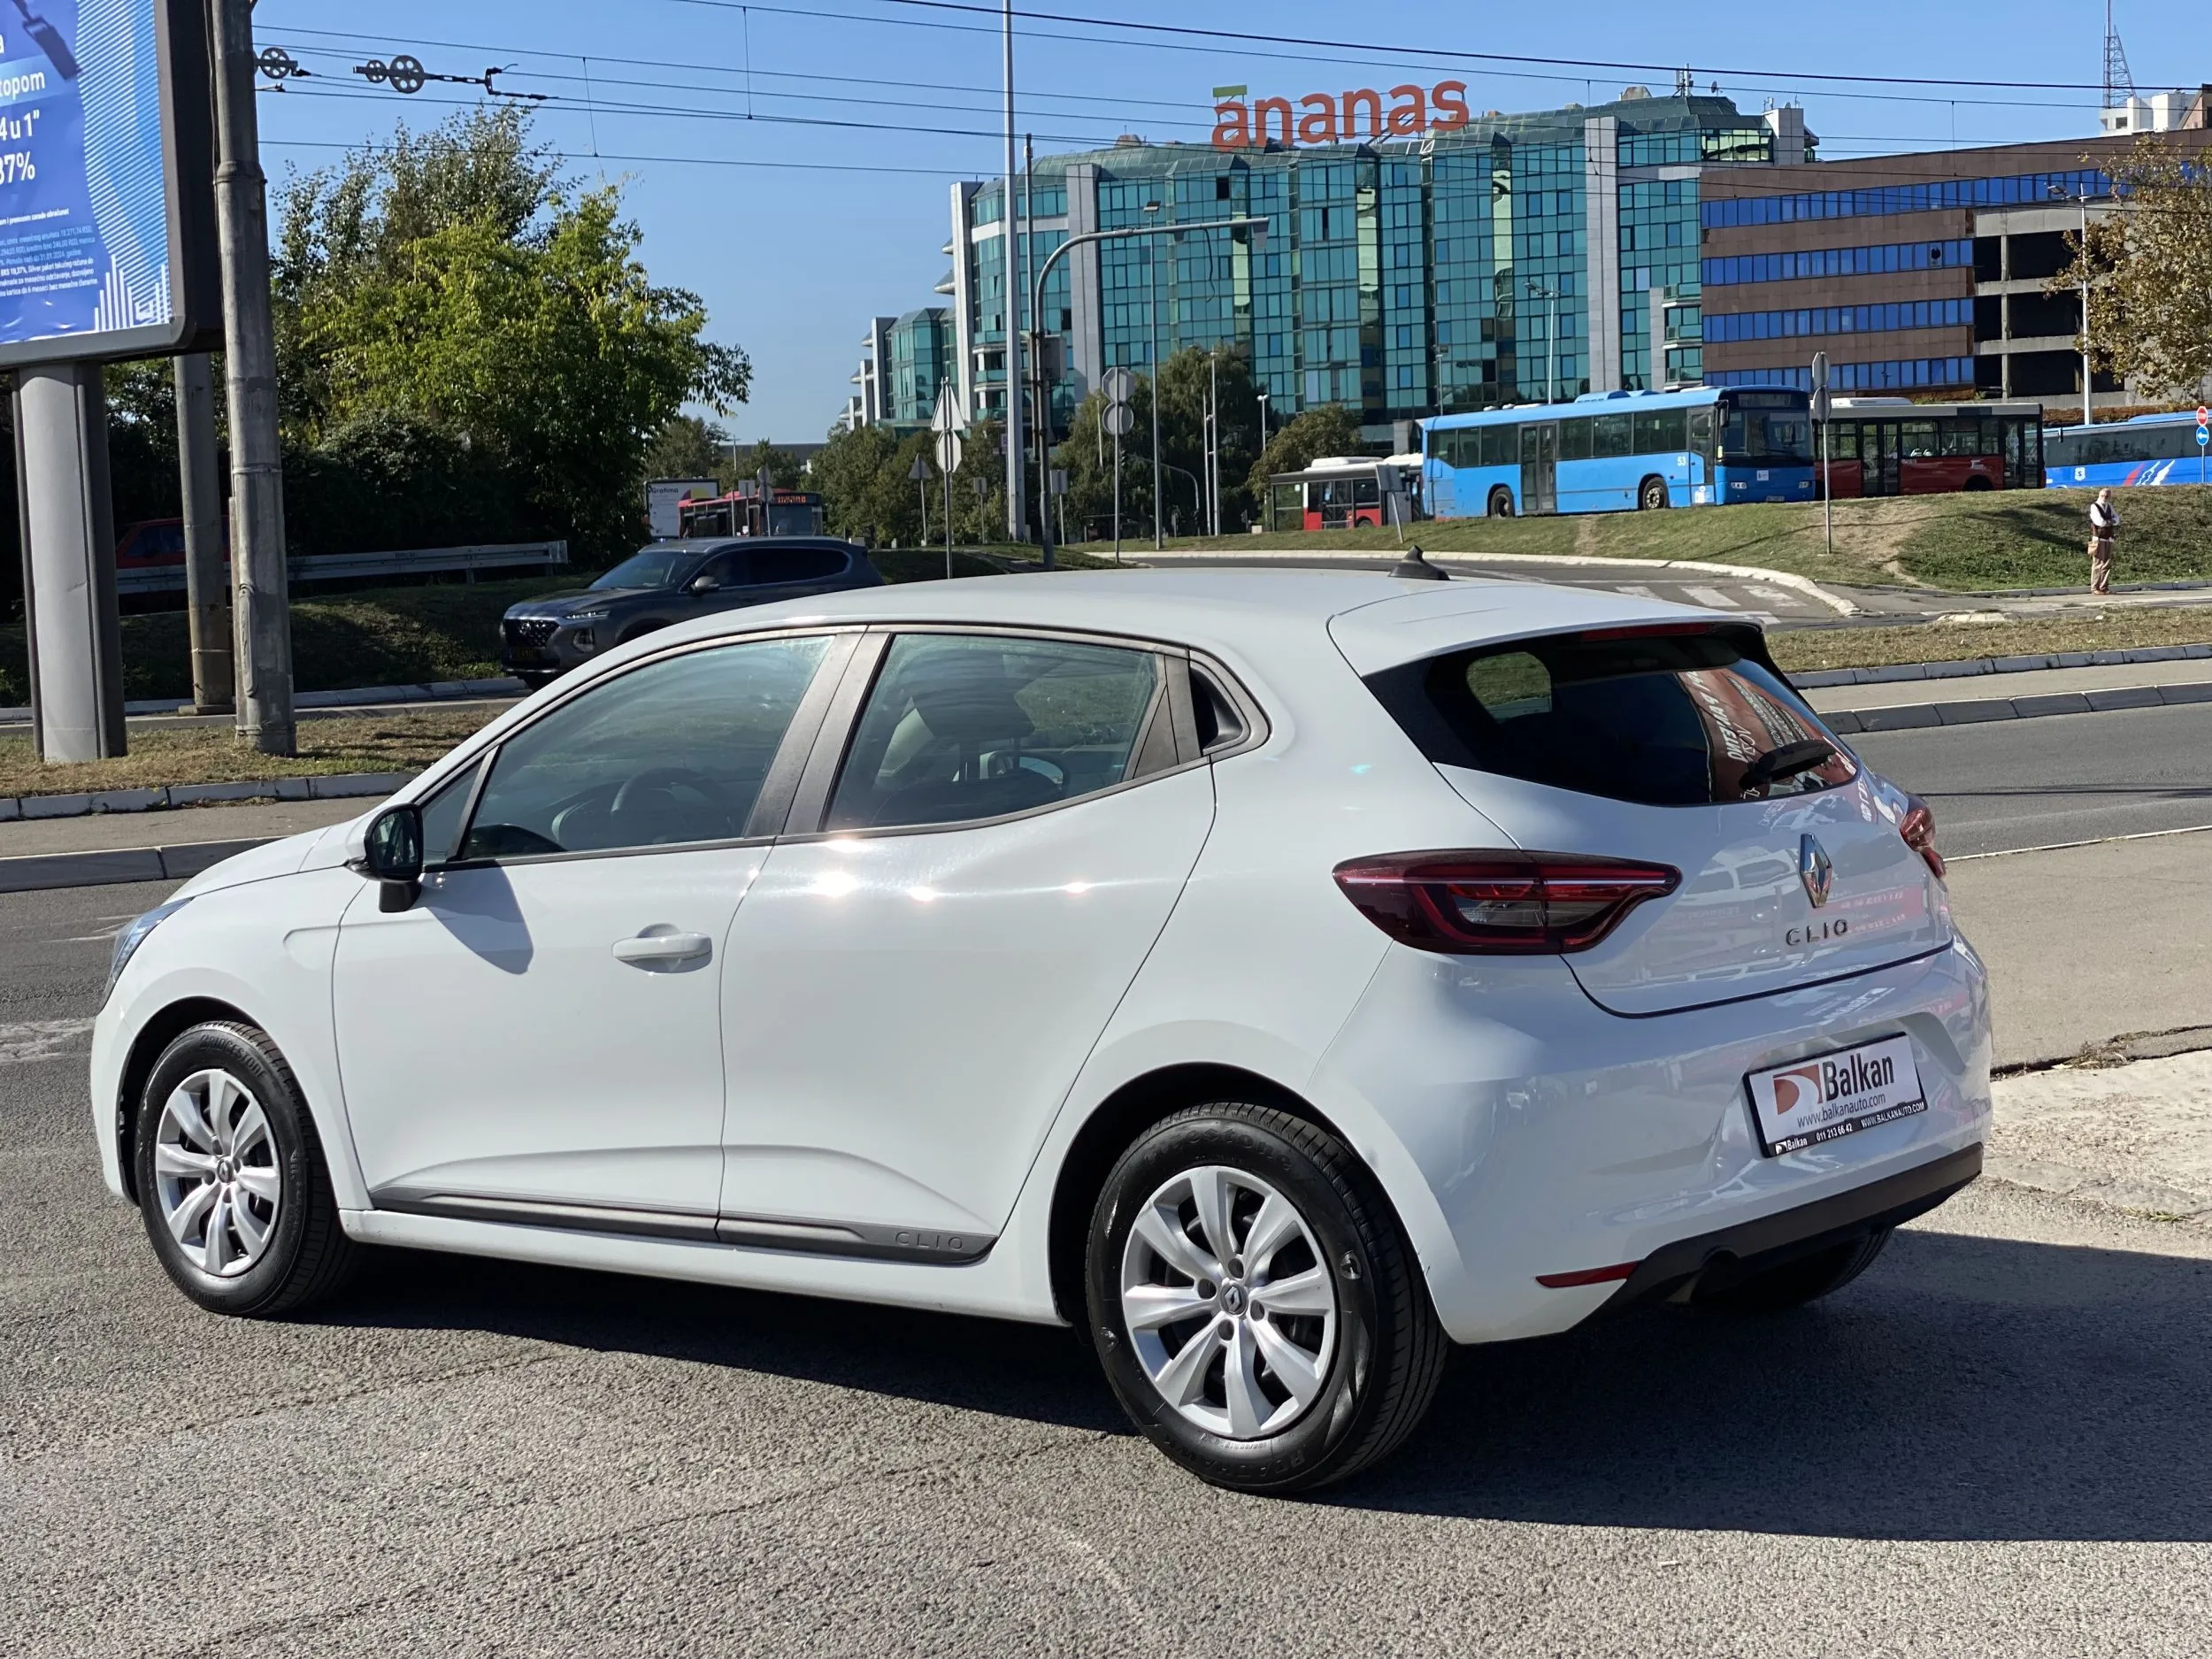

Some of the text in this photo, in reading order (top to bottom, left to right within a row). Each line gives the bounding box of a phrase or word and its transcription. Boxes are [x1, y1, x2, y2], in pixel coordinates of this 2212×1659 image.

[1677, 456, 1686, 467] 53
[1786, 918, 1848, 947] CLIO
[1823, 1052, 1894, 1102] Balkan
[1797, 1093, 1886, 1128] www.balkanauto.com
[1787, 1138, 1808, 1150] Balkan
[895, 1231, 963, 1251] CLIO
